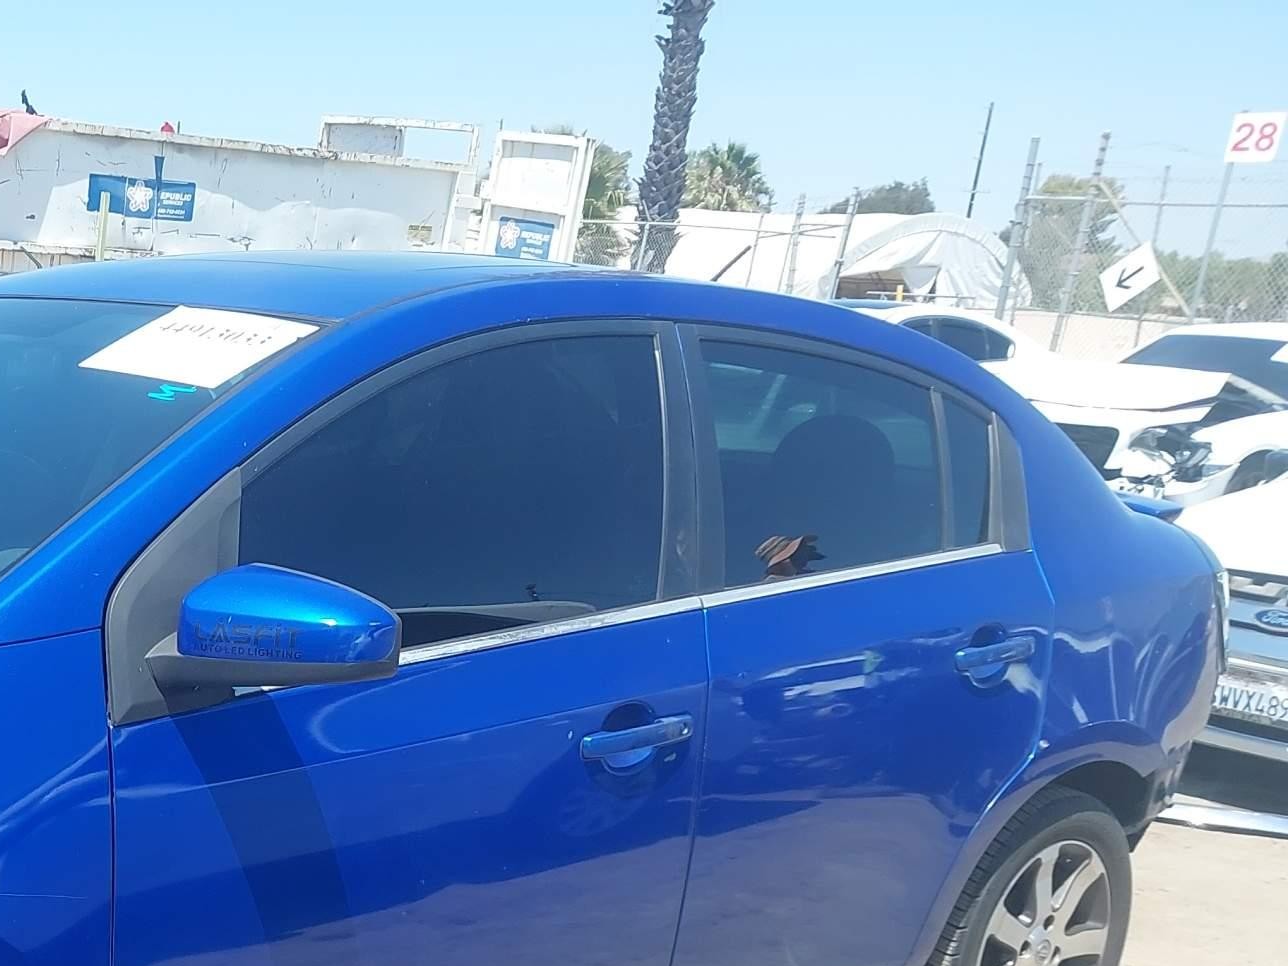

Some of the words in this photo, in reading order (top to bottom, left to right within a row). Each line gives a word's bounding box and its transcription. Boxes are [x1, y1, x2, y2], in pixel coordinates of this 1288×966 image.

[1231, 122, 1278, 151] 28
[224, 646, 245, 656] LED
[248, 647, 304, 660] LIGHTING
[1214, 685, 1288, 719] WVX489
